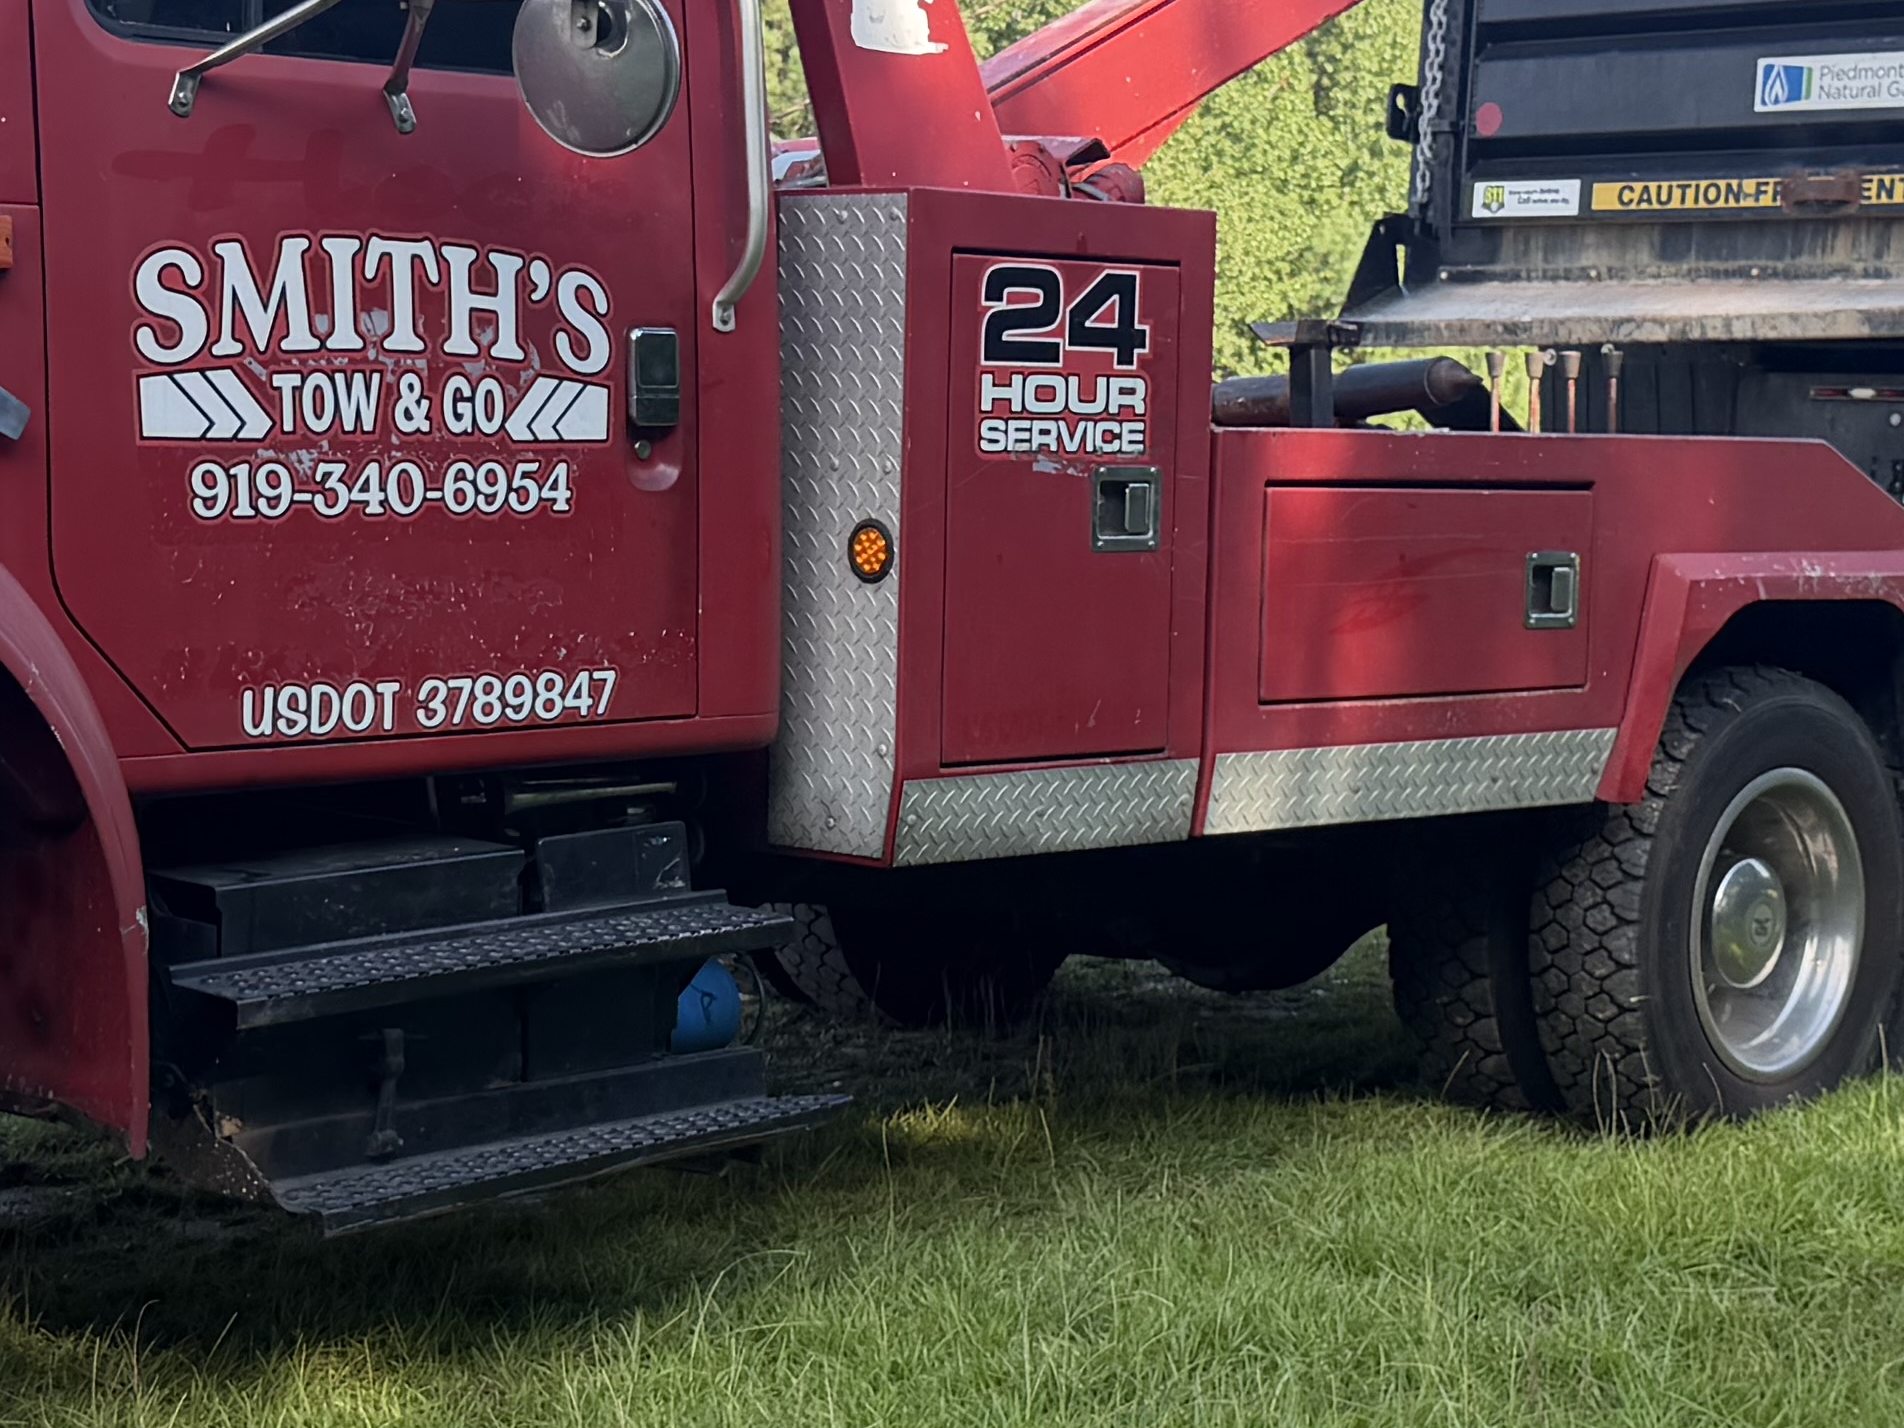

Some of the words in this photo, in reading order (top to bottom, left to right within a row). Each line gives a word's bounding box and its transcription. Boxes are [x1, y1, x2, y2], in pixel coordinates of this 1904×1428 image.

[1817, 83, 1882, 101] Natural
[1818, 63, 1904, 83] Piedmont
[133, 235, 614, 376] SMITH'S
[980, 262, 1150, 370] 24
[271, 370, 382, 436] TOW
[395, 372, 431, 435] &
[442, 373, 505, 435] GO
[980, 373, 1146, 414] HOUR
[979, 419, 1145, 453] SERVICE
[190, 460, 573, 519] 919-340-6954
[242, 682, 401, 736] USDOT
[415, 670, 617, 727] 3789847
